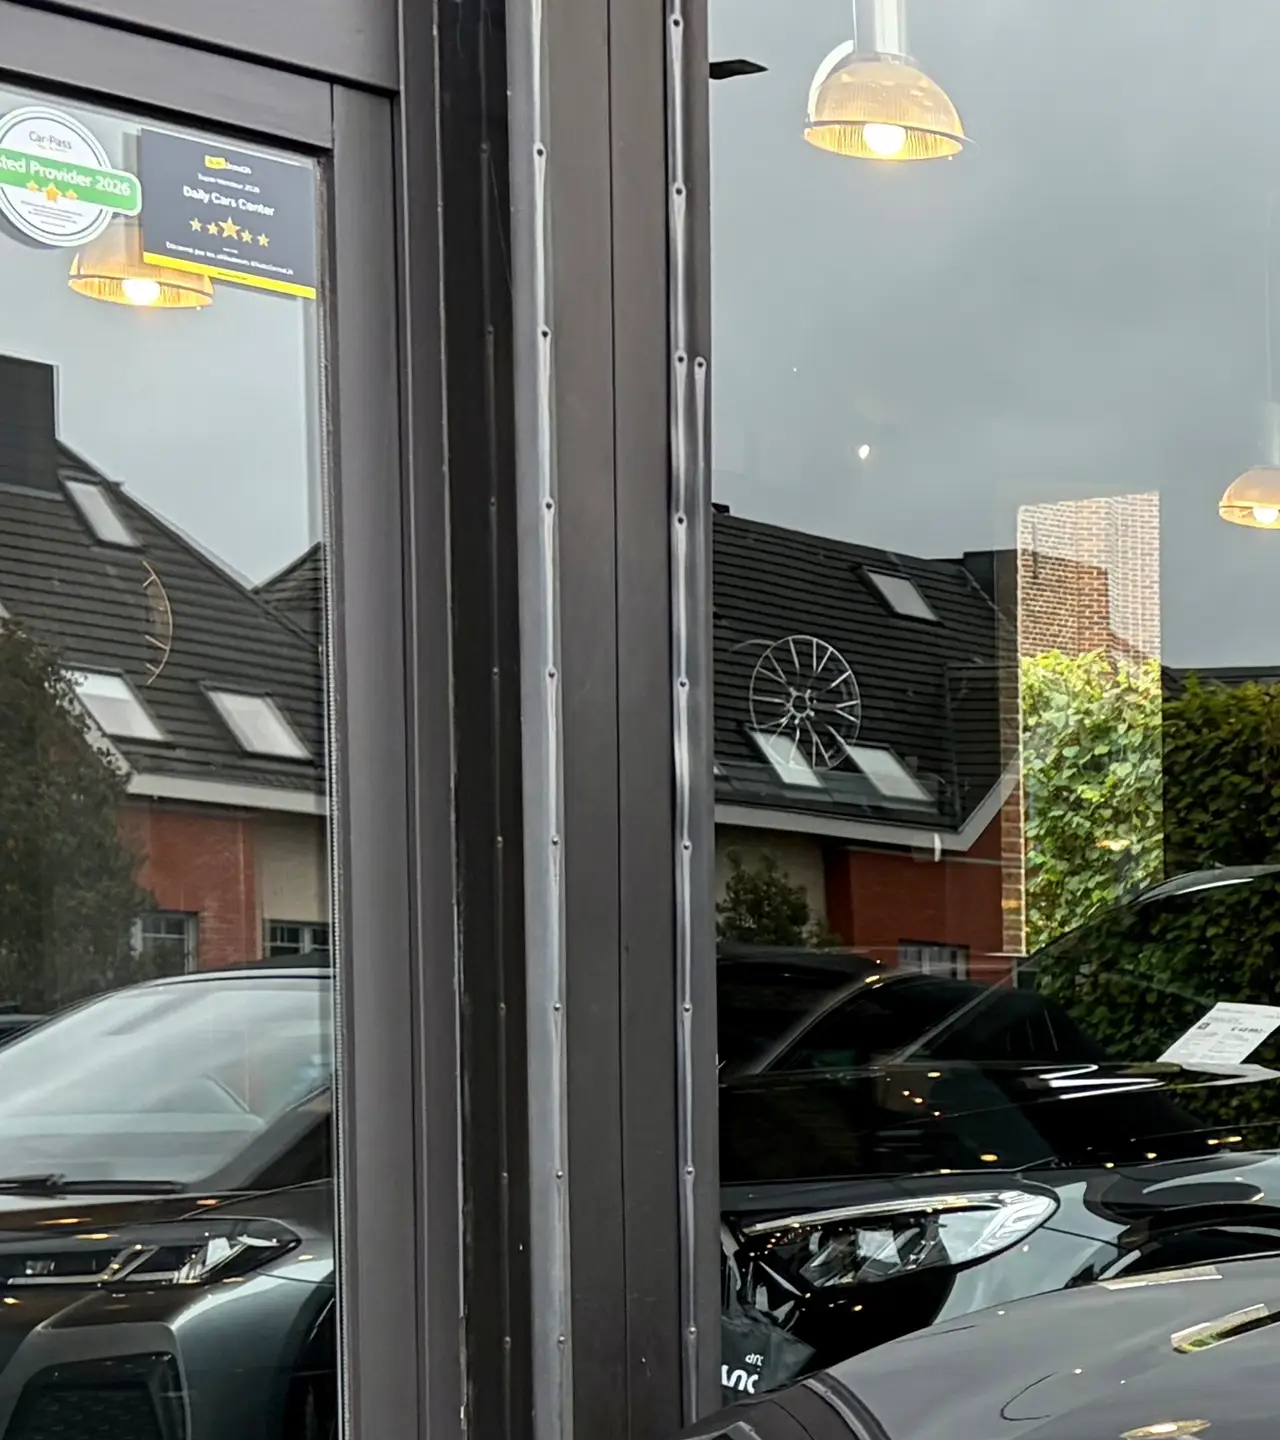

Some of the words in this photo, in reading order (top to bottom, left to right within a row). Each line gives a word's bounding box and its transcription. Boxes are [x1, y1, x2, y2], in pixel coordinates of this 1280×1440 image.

[30, 160, 93, 188] Provider
[95, 175, 131, 197] 2026
[183, 185, 210, 204] Daily
[211, 192, 237, 208] Cars
[238, 198, 275, 217] Center
